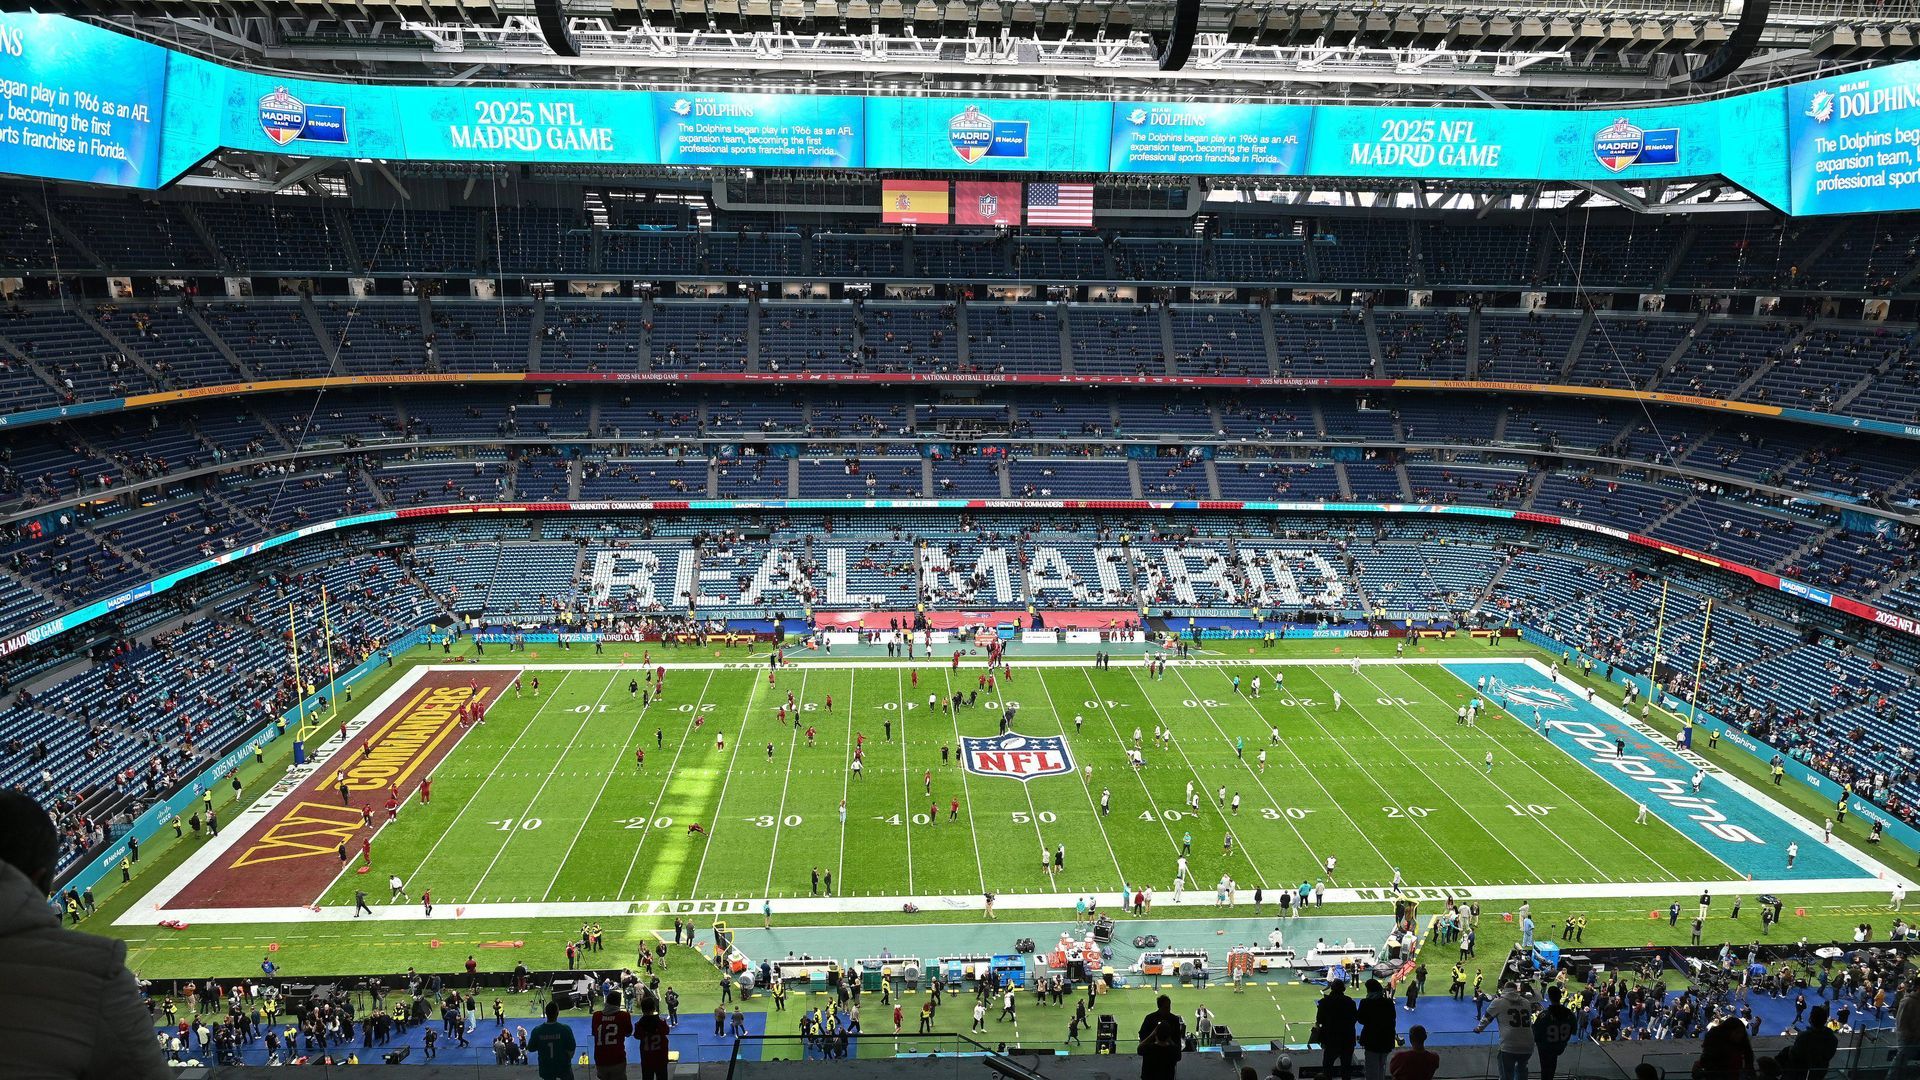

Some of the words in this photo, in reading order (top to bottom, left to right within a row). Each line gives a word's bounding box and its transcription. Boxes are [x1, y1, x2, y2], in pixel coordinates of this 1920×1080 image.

[1840, 80, 1870, 93] MIAMI
[31, 83, 55, 107] play
[59, 87, 69, 106] in
[74, 91, 99, 112] 1966
[102, 102, 115, 115] as
[117, 104, 129, 118] an
[131, 104, 150, 123] AFL
[262, 112, 301, 122] MADRID
[475, 101, 535, 125] 2025
[539, 103, 582, 126] NFL
[695, 104, 753, 117] DOLPHINS
[8, 100, 67, 133] becoming
[71, 114, 88, 132] the
[91, 117, 111, 136] first
[1151, 113, 1206, 127] DOLPHINS
[678, 123, 693, 133] The
[696, 124, 731, 135] Dolphins
[734, 125, 760, 136] began
[762, 126, 778, 136] play
[781, 126, 788, 134] in
[791, 126, 811, 134] 1966
[825, 128, 835, 136] an
[838, 127, 854, 136] AFL
[952, 132, 990, 140] MADRID
[1381, 120, 1435, 142] 2025
[1438, 121, 1476, 143] NFL
[23, 127, 75, 152] franchise
[78, 136, 88, 154] in
[91, 138, 127, 160] Florida.
[451, 125, 542, 150] MADRID
[547, 127, 614, 151] GAME
[679, 135, 720, 144] expansion
[722, 135, 745, 144] team,
[748, 136, 788, 146] becoming
[791, 136, 803, 144] the
[806, 137, 822, 145] first
[1131, 133, 1146, 141] The
[1149, 133, 1182, 143] Dolphins
[1184, 134, 1209, 144] began
[1211, 134, 1226, 144] play
[1240, 135, 1258, 143] 1966
[1284, 136, 1298, 144] AFL
[1815, 138, 1836, 154] The
[1840, 131, 1892, 152] Dolphins
[680, 145, 728, 154] professional
[731, 146, 756, 154] sports
[759, 146, 795, 154] franchise
[798, 146, 805, 154] in
[1130, 143, 1170, 153] expansion
[1172, 144, 1193, 152] team,
[1196, 144, 1234, 154] becoming
[1238, 145, 1250, 153] the
[1252, 145, 1266, 153] first
[1598, 142, 1638, 150] MADRID
[1130, 153, 1176, 162] professional
[1178, 154, 1202, 162] sports
[1205, 154, 1240, 162] franchise
[1242, 154, 1249, 162] in
[1350, 143, 1435, 167] MADRID
[1438, 145, 1501, 166] GAME
[1816, 154, 1874, 175] expansion
[1878, 150, 1912, 166] team,
[1817, 170, 1885, 195] professional
[981, 205, 996, 214] NFL
[612, 502, 653, 510] COMMANDERS
[1560, 518, 1596, 532] WASHINGTON
[1597, 525, 1629, 540] COMMANDERS
[593, 548, 886, 606] REAL
[918, 547, 1348, 604] MADRID
[1782, 582, 1807, 594] MADRID
[108, 594, 131, 608] MADRID
[1404, 611, 1440, 620] DOLPHINS
[1875, 611, 1898, 628] 2025
[1898, 618, 1914, 634] NFL
[8, 627, 40, 653] MADRID
[41, 618, 64, 637] GAME
[1344, 630, 1370, 638] MADRID
[1629, 723, 1661, 740] END
[334, 687, 474, 791] COMMANDERS
[1724, 730, 1758, 752] Dolphins
[212, 761, 227, 780] 2025
[227, 755, 238, 770] NFL
[259, 727, 274, 745] GAME
[247, 804, 272, 814] IT
[346, 720, 367, 730] US
[976, 751, 1061, 774] NFL
[1549, 720, 1766, 844] Dolphins
[1807, 773, 1820, 788] VISA
[1138, 810, 1181, 822] 40
[1260, 808, 1306, 820] 30
[1382, 806, 1429, 818] 20
[1505, 804, 1549, 816] 10
[159, 813, 172, 826] cisco
[497, 818, 542, 831] 10
[624, 817, 672, 829] 20
[755, 815, 802, 827] 30
[885, 813, 929, 826] 40
[1012, 811, 1056, 824] 50
[1861, 806, 1892, 829] Santander
[108, 846, 126, 862] NetApp
[1356, 888, 1472, 900] MADRID
[627, 901, 750, 914] MADRID
[1508, 1008, 1530, 1028] 32
[597, 1024, 618, 1046] 12
[643, 1034, 661, 1051] 12
[547, 1042, 554, 1058] 1
